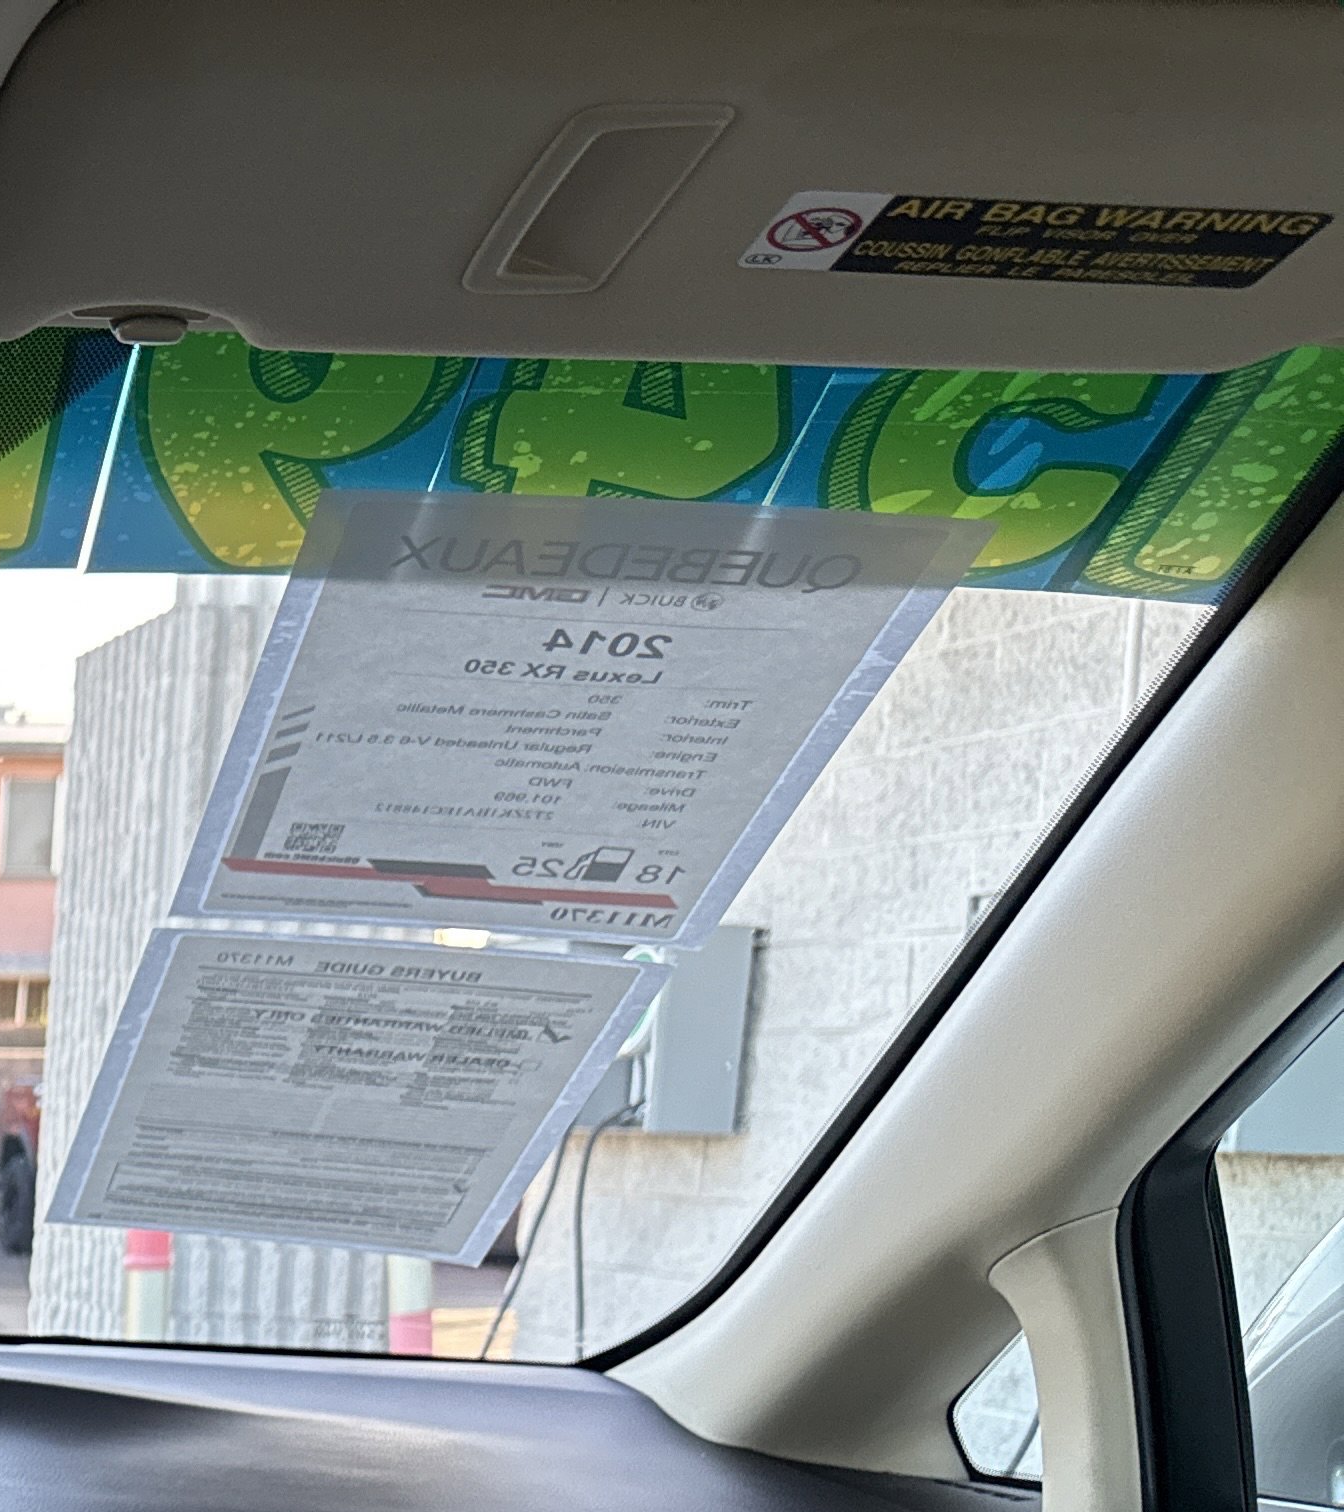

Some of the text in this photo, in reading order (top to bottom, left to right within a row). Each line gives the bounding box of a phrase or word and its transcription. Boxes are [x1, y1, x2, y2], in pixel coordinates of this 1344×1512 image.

[887, 199, 1320, 237] AIR BAG WARNING
[854, 240, 1276, 272] COUSSIN GONFLABLE AVERTISSEMENT
